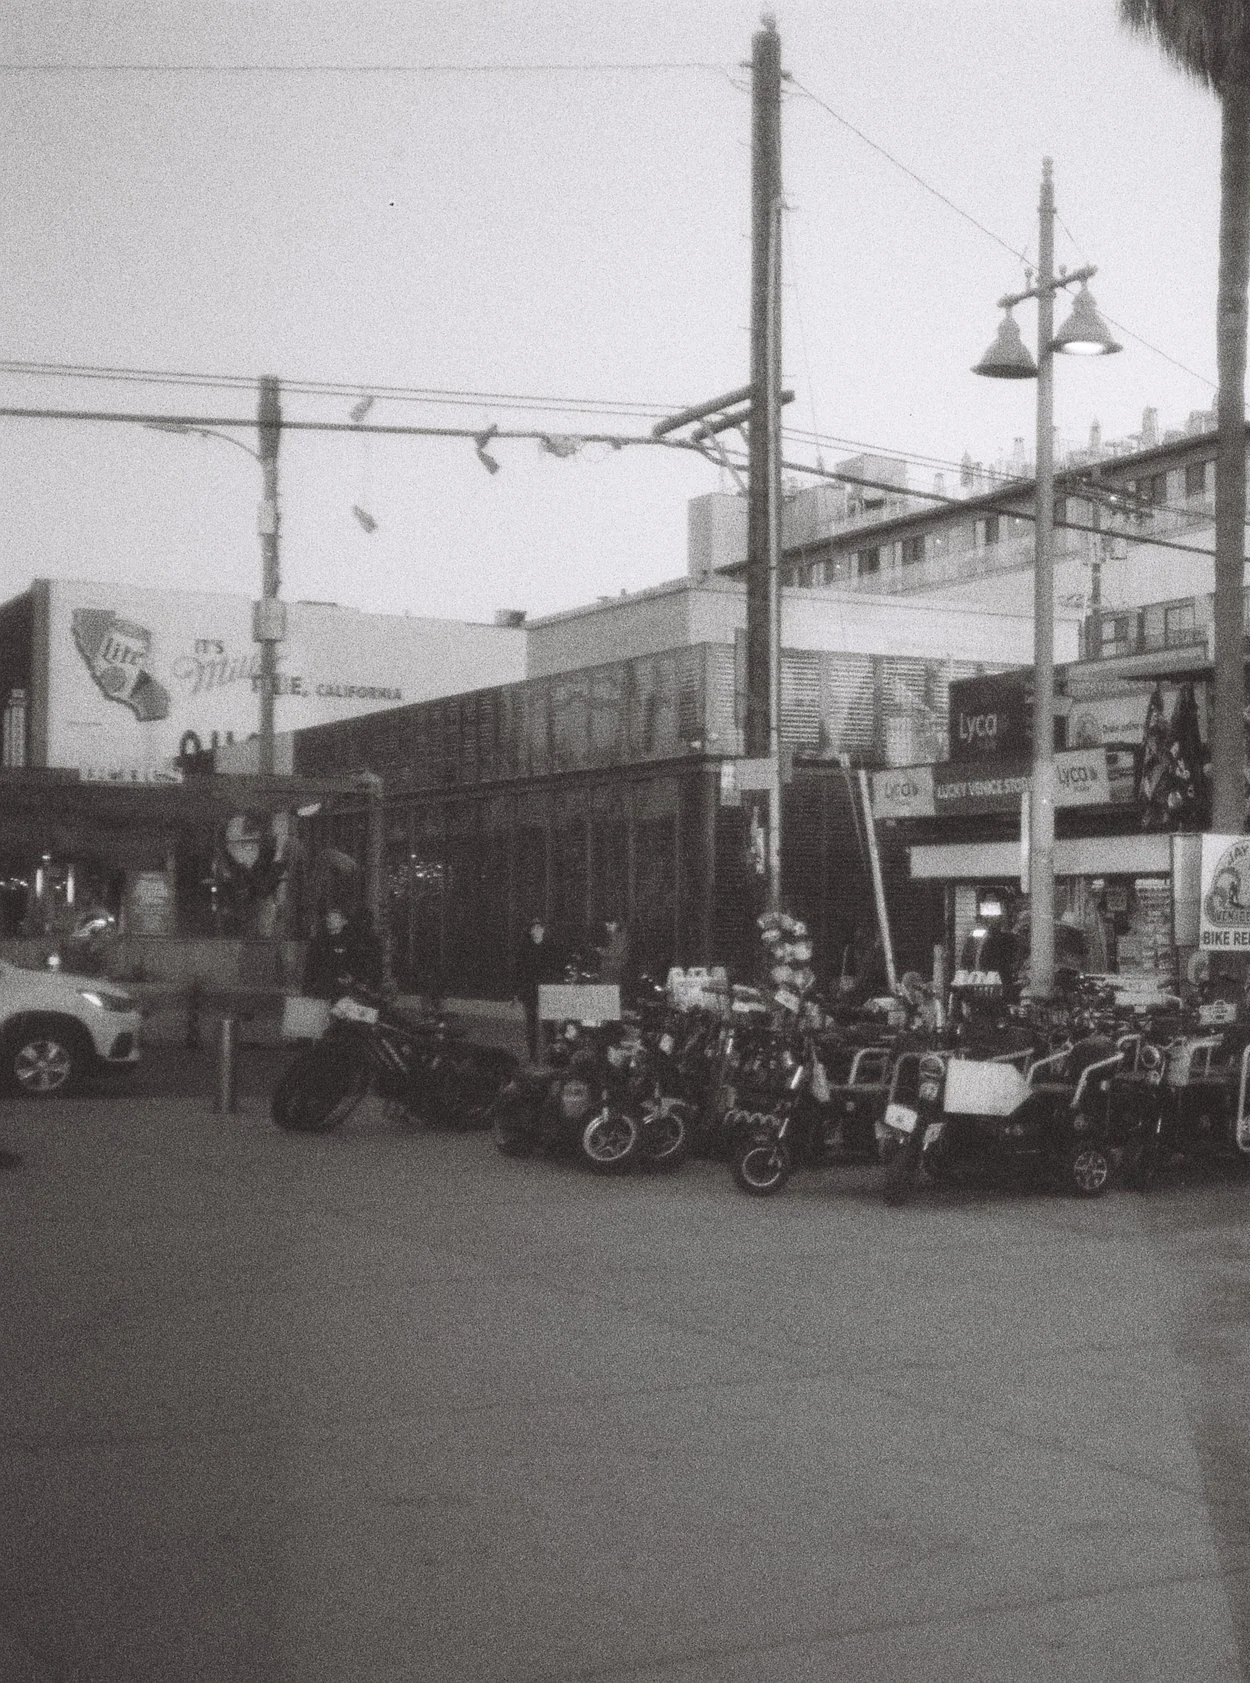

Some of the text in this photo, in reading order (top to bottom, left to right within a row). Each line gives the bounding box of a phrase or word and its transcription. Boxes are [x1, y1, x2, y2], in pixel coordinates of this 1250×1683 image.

[316, 683, 403, 700] CALIFORNIA
[960, 712, 997, 743] Lyca
[1056, 765, 1088, 787] Lyca
[1203, 930, 1230, 946] BIKE
